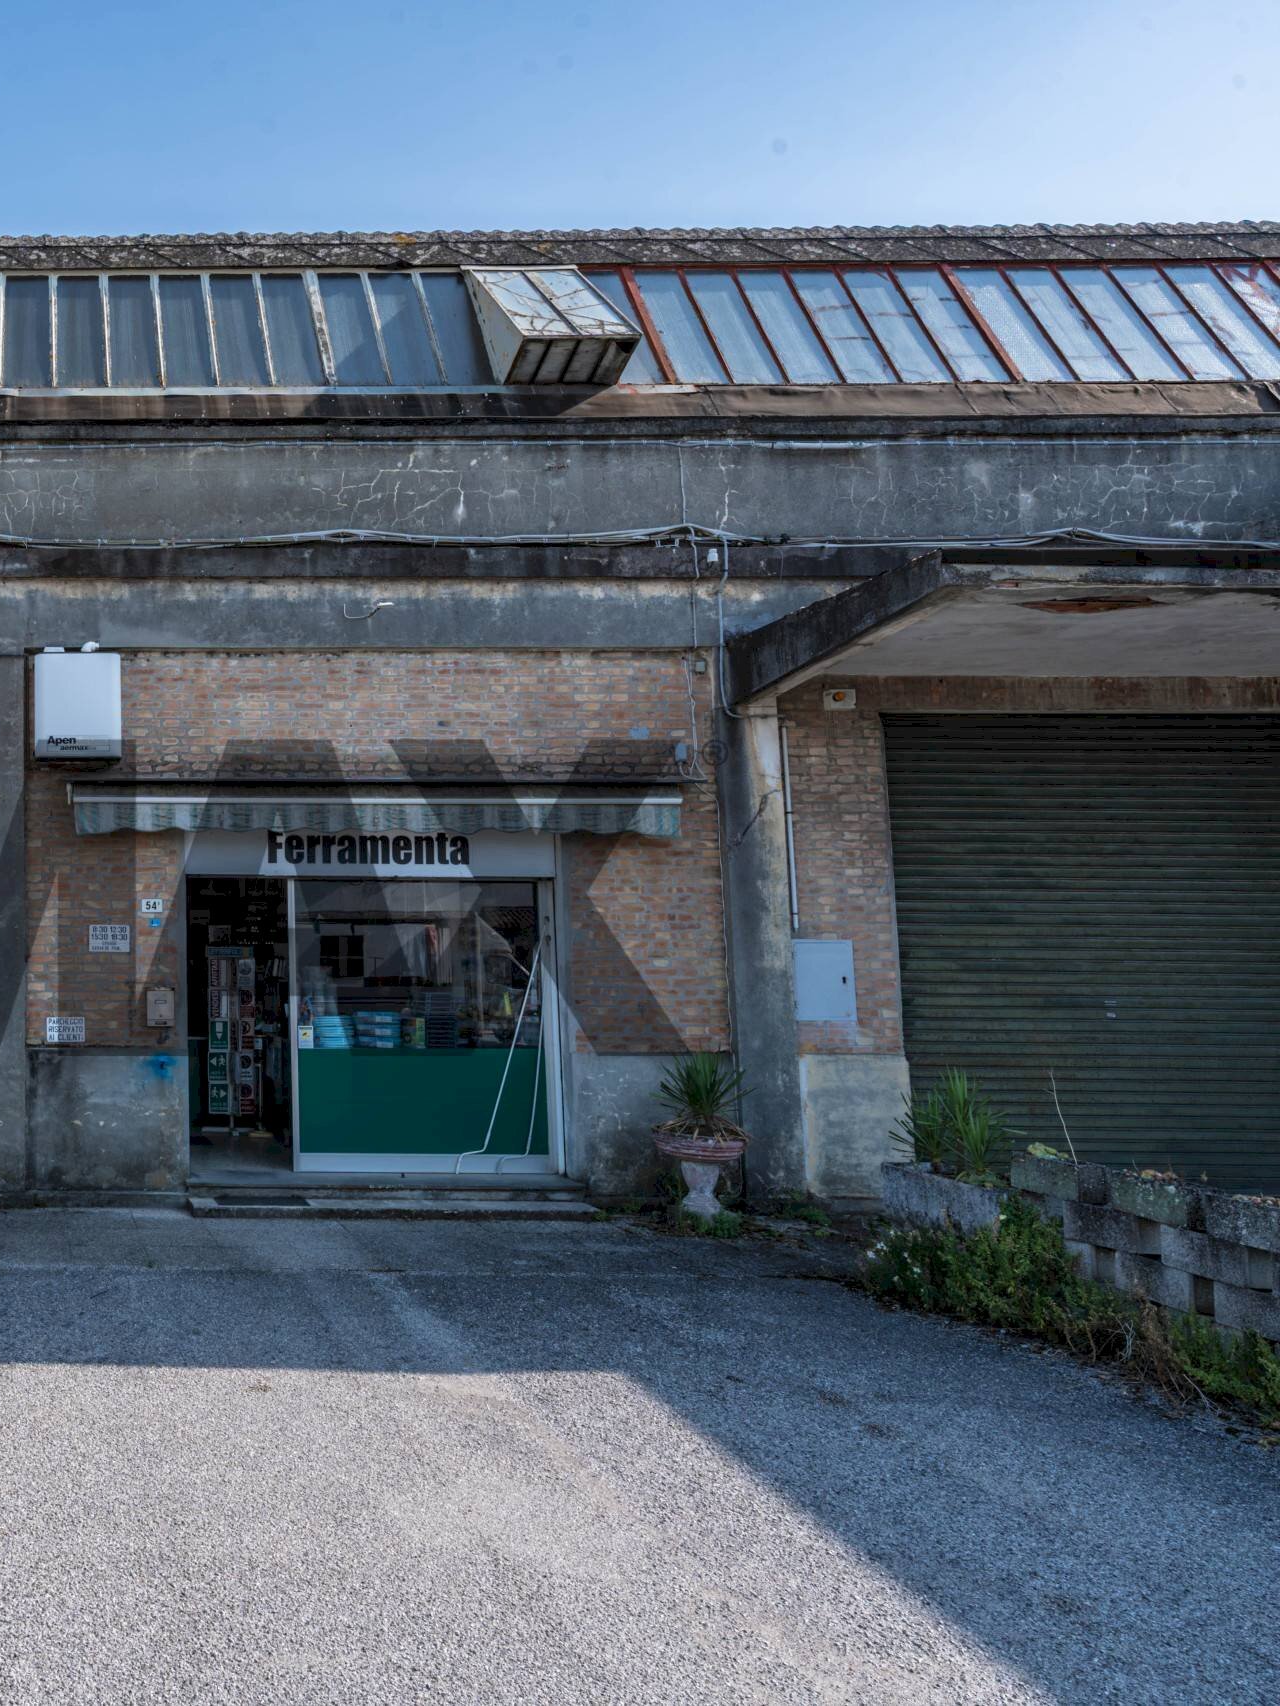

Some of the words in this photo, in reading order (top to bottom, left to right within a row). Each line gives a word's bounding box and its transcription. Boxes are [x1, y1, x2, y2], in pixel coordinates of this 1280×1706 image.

[47, 736, 77, 747] Apen
[267, 831, 470, 865] Ferramenta
[48, 1025, 84, 1033] RISERVATO
